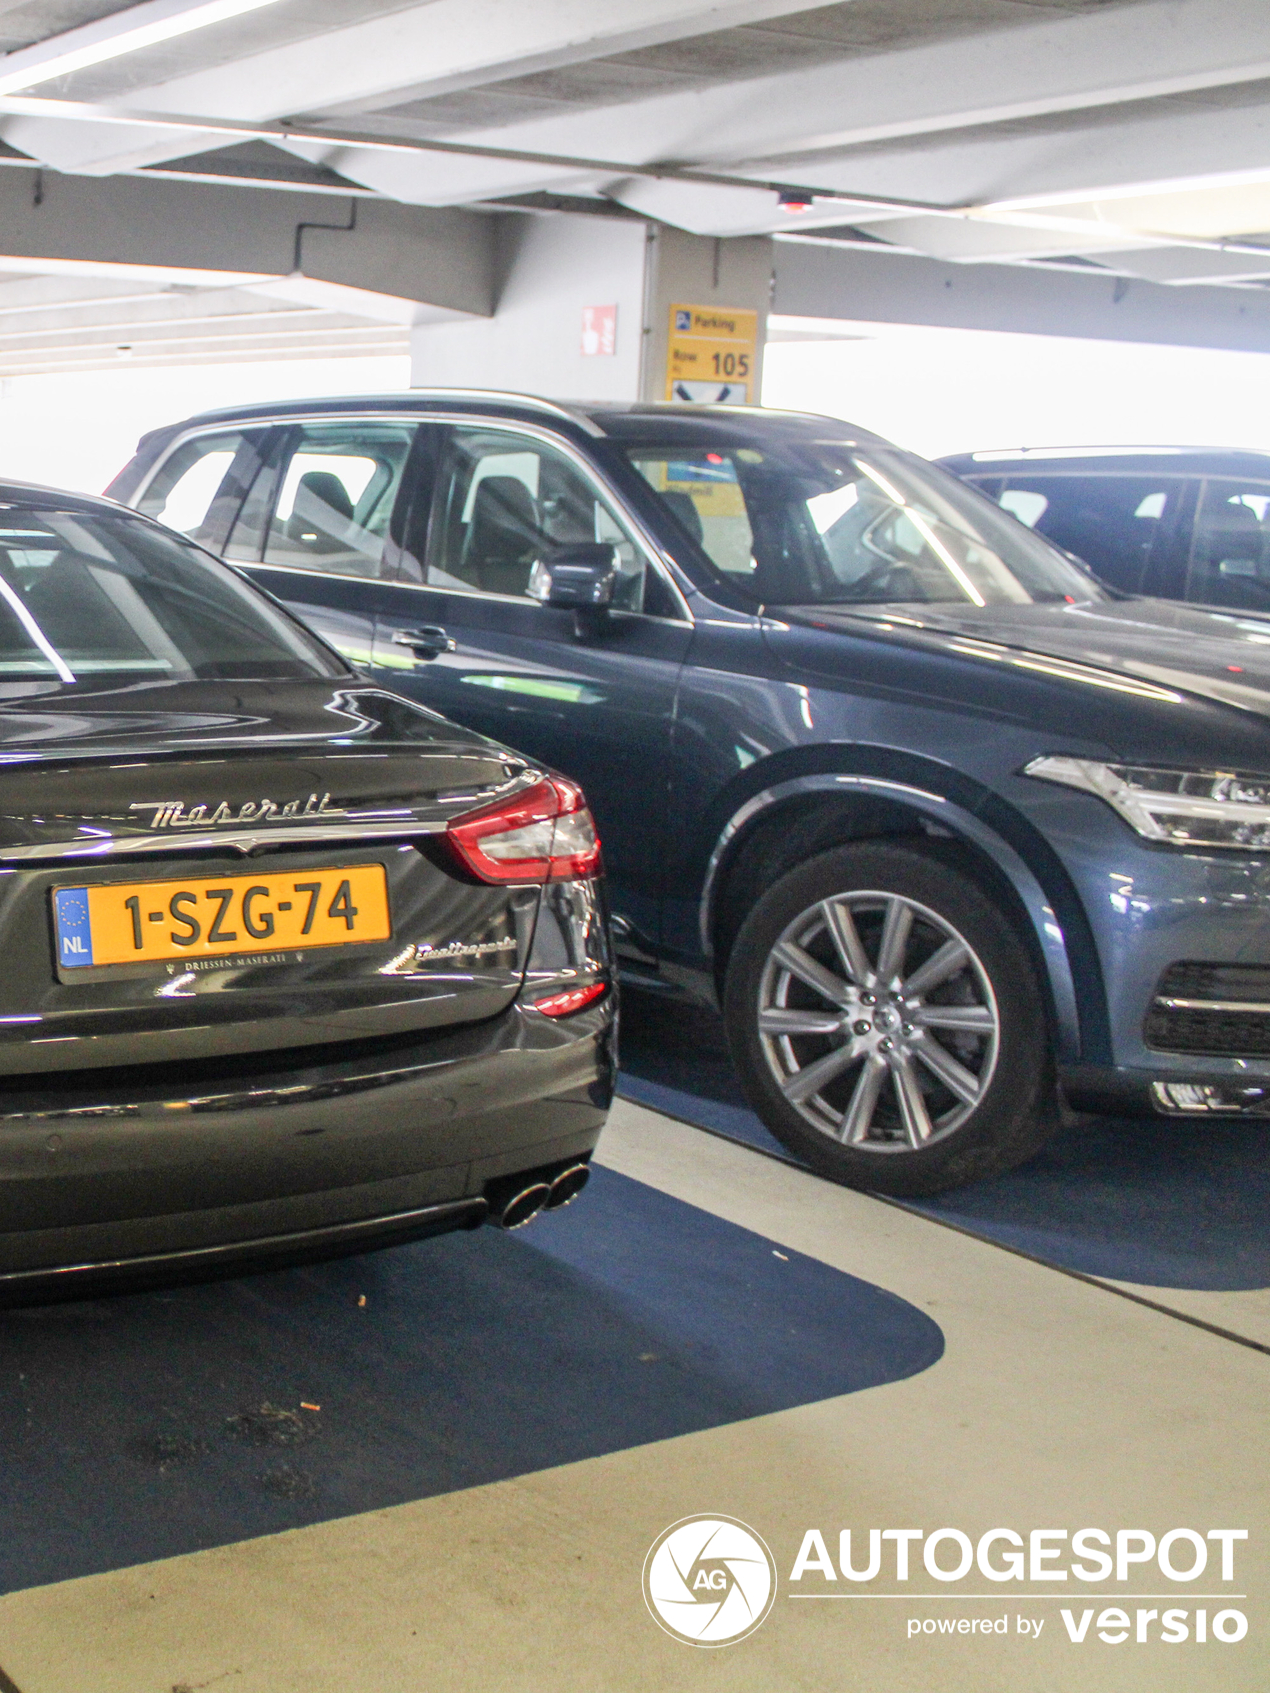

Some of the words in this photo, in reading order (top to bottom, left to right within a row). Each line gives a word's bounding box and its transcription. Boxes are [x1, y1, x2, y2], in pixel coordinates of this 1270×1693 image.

[695, 315, 735, 332] Parking
[673, 349, 697, 361] Row
[712, 352, 749, 376] 105
[129, 793, 348, 828] Maserati
[125, 879, 358, 950] 1-SZG-74
[63, 936, 89, 955] NL
